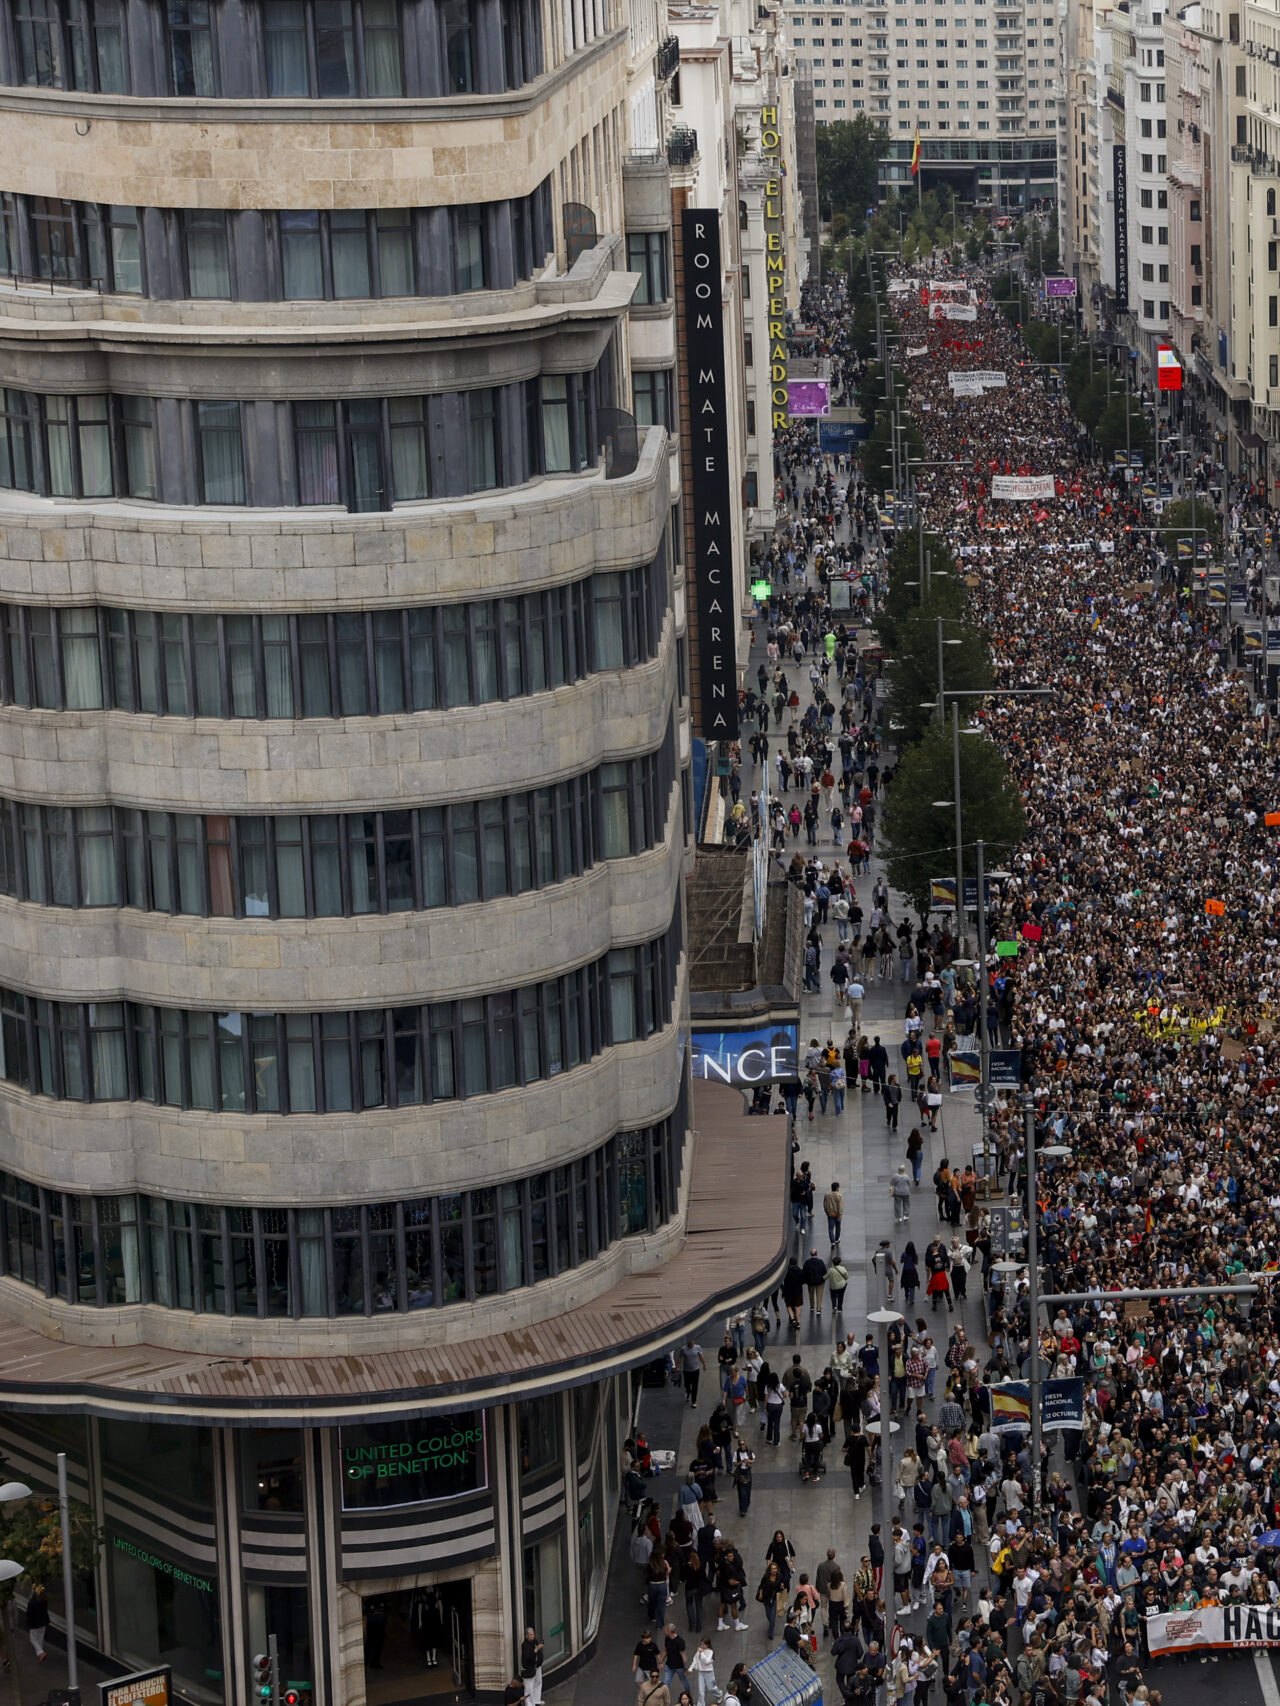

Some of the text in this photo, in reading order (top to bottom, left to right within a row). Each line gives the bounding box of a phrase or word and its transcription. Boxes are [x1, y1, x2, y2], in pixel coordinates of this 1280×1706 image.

[1117, 150, 1125, 213] CATALONIA
[1118, 218, 1126, 253] PLAZA
[762, 106, 790, 429] HOEL EMPERADOR
[694, 223, 727, 727] ROOM MATE MACARENA
[1030, 482, 1051, 492] GENERAL
[691, 1046, 792, 1084] NCE
[1045, 1398, 1074, 1406] NACIONAL
[345, 1427, 483, 1462] UNITED COLORS
[347, 1465, 372, 1480] OF
[113, 1537, 137, 1557] UNITED
[137, 1550, 163, 1570] COLORS
[163, 1563, 173, 1574] OF
[1232, 1640, 1270, 1648] BAJADA
[108, 1674, 165, 1699] PARA REDUCIR
[108, 1683, 166, 1706] EL COLESTEROL
